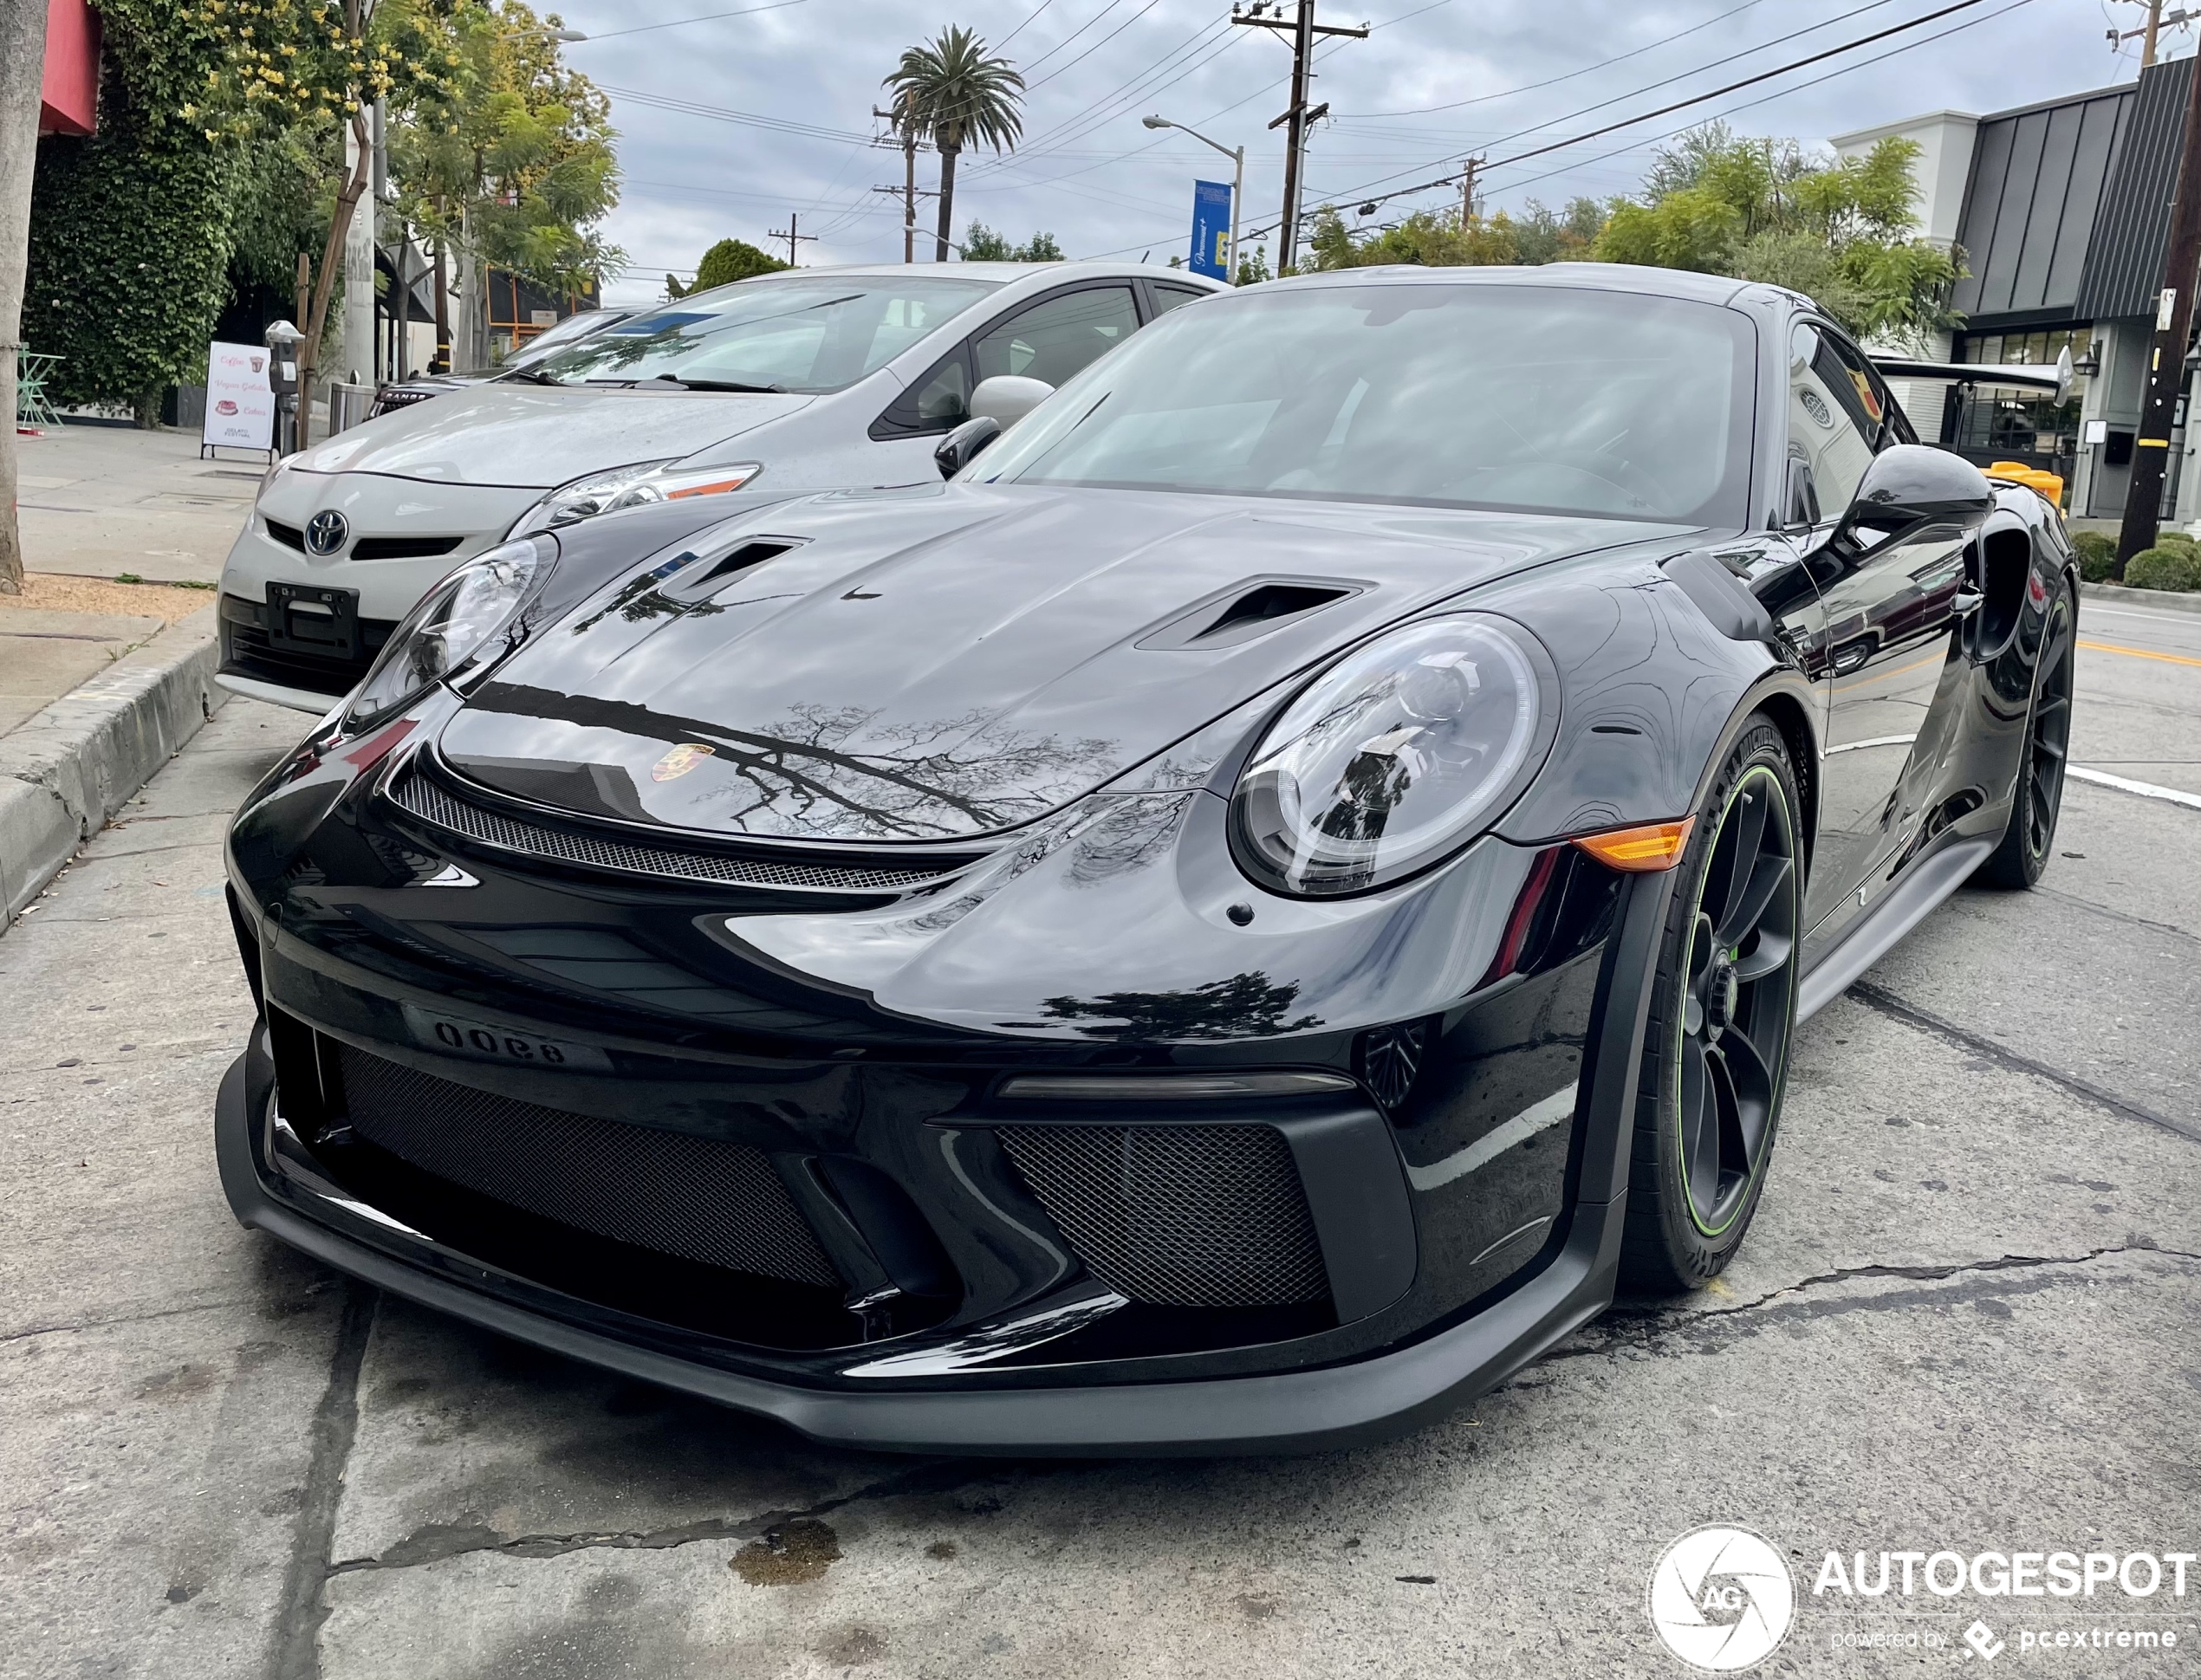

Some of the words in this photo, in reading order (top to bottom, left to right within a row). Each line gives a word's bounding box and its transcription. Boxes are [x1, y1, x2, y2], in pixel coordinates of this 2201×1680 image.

[220, 356, 244, 366] Coffee
[215, 379, 239, 391] Vegan
[242, 382, 266, 392] Gelato
[243, 406, 266, 416] Cakes
[1738, 727, 1781, 765] MICHELIN
